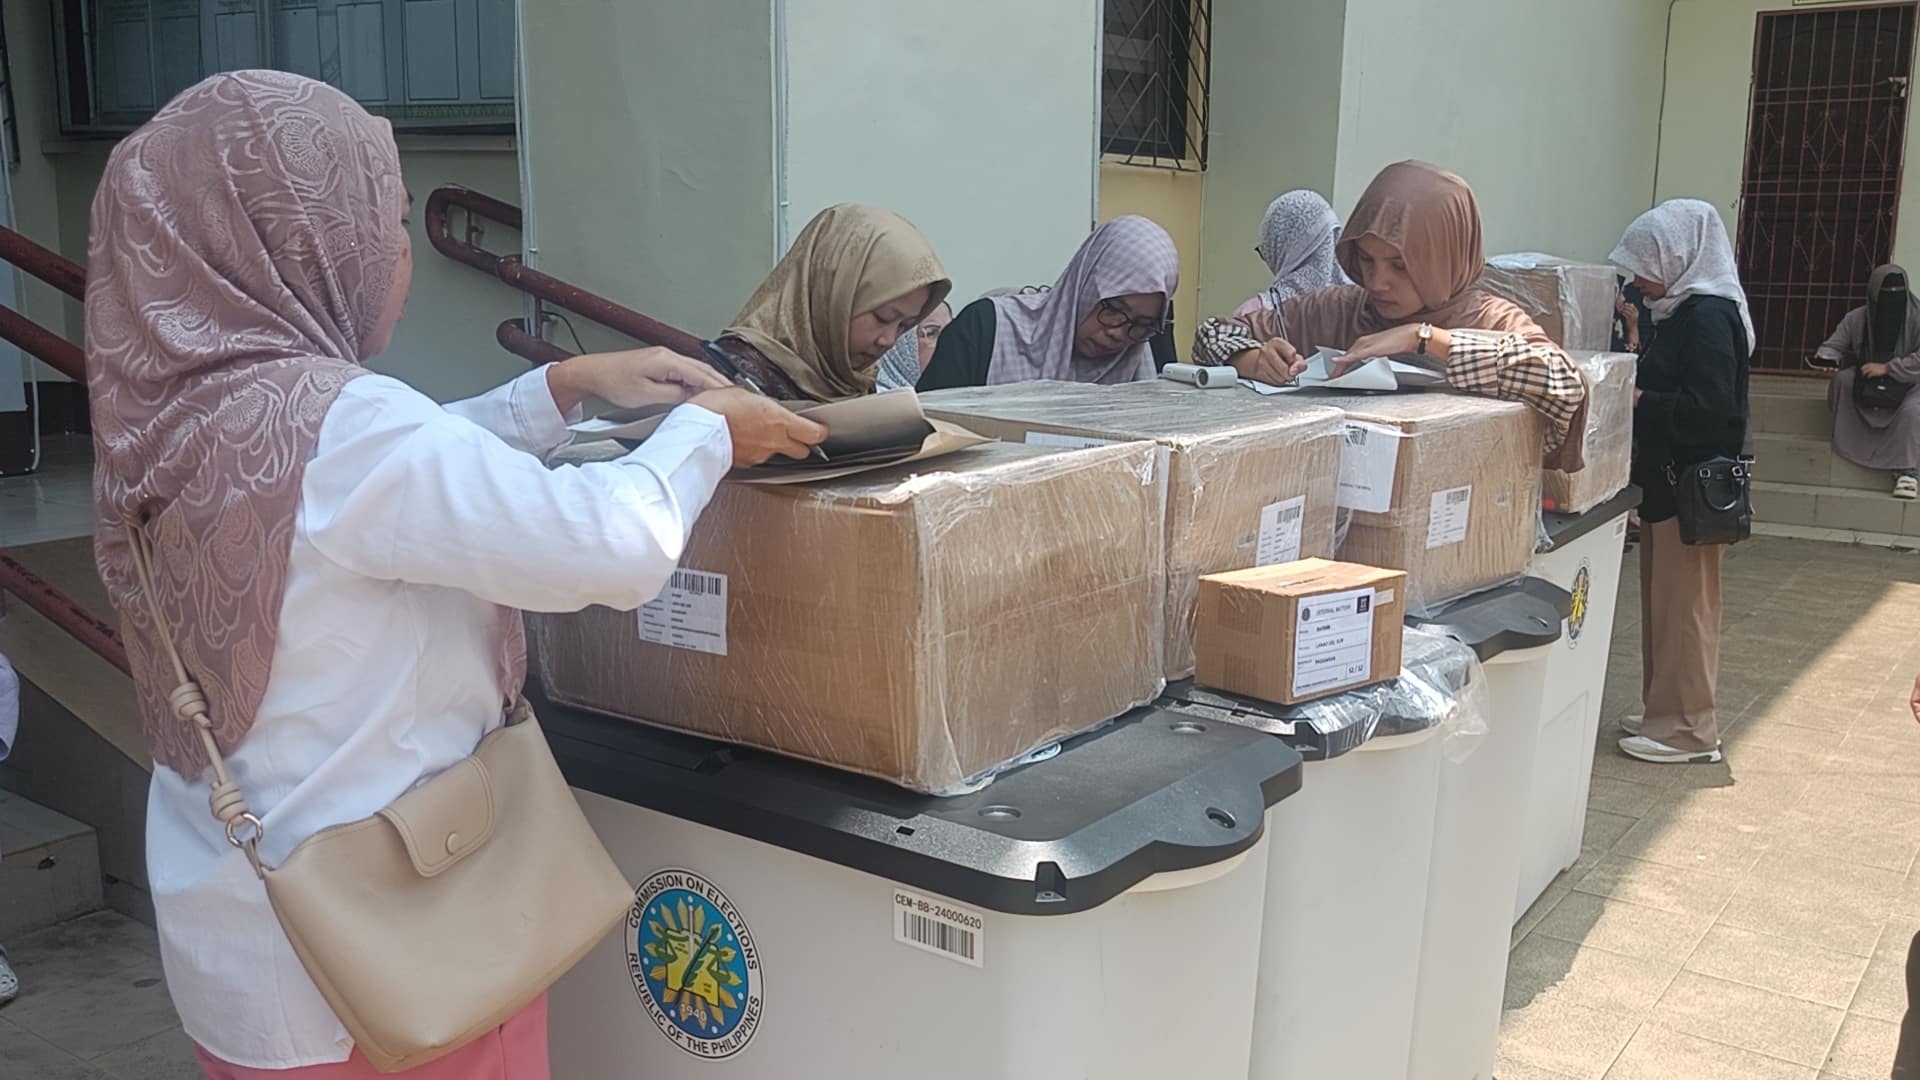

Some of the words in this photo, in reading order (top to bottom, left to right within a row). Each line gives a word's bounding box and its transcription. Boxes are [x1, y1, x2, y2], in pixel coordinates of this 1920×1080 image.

[629, 874, 683, 929] COMMISSION
[686, 877, 704, 894] ON
[706, 887, 757, 971] ELECTIONS
[895, 893, 982, 929] CEM-BB-24000620
[629, 951, 669, 1026] REPUBLIC
[667, 1024, 683, 1041] OF
[686, 1035, 709, 1054] THE
[711, 995, 760, 1055] PHILIPPINES
